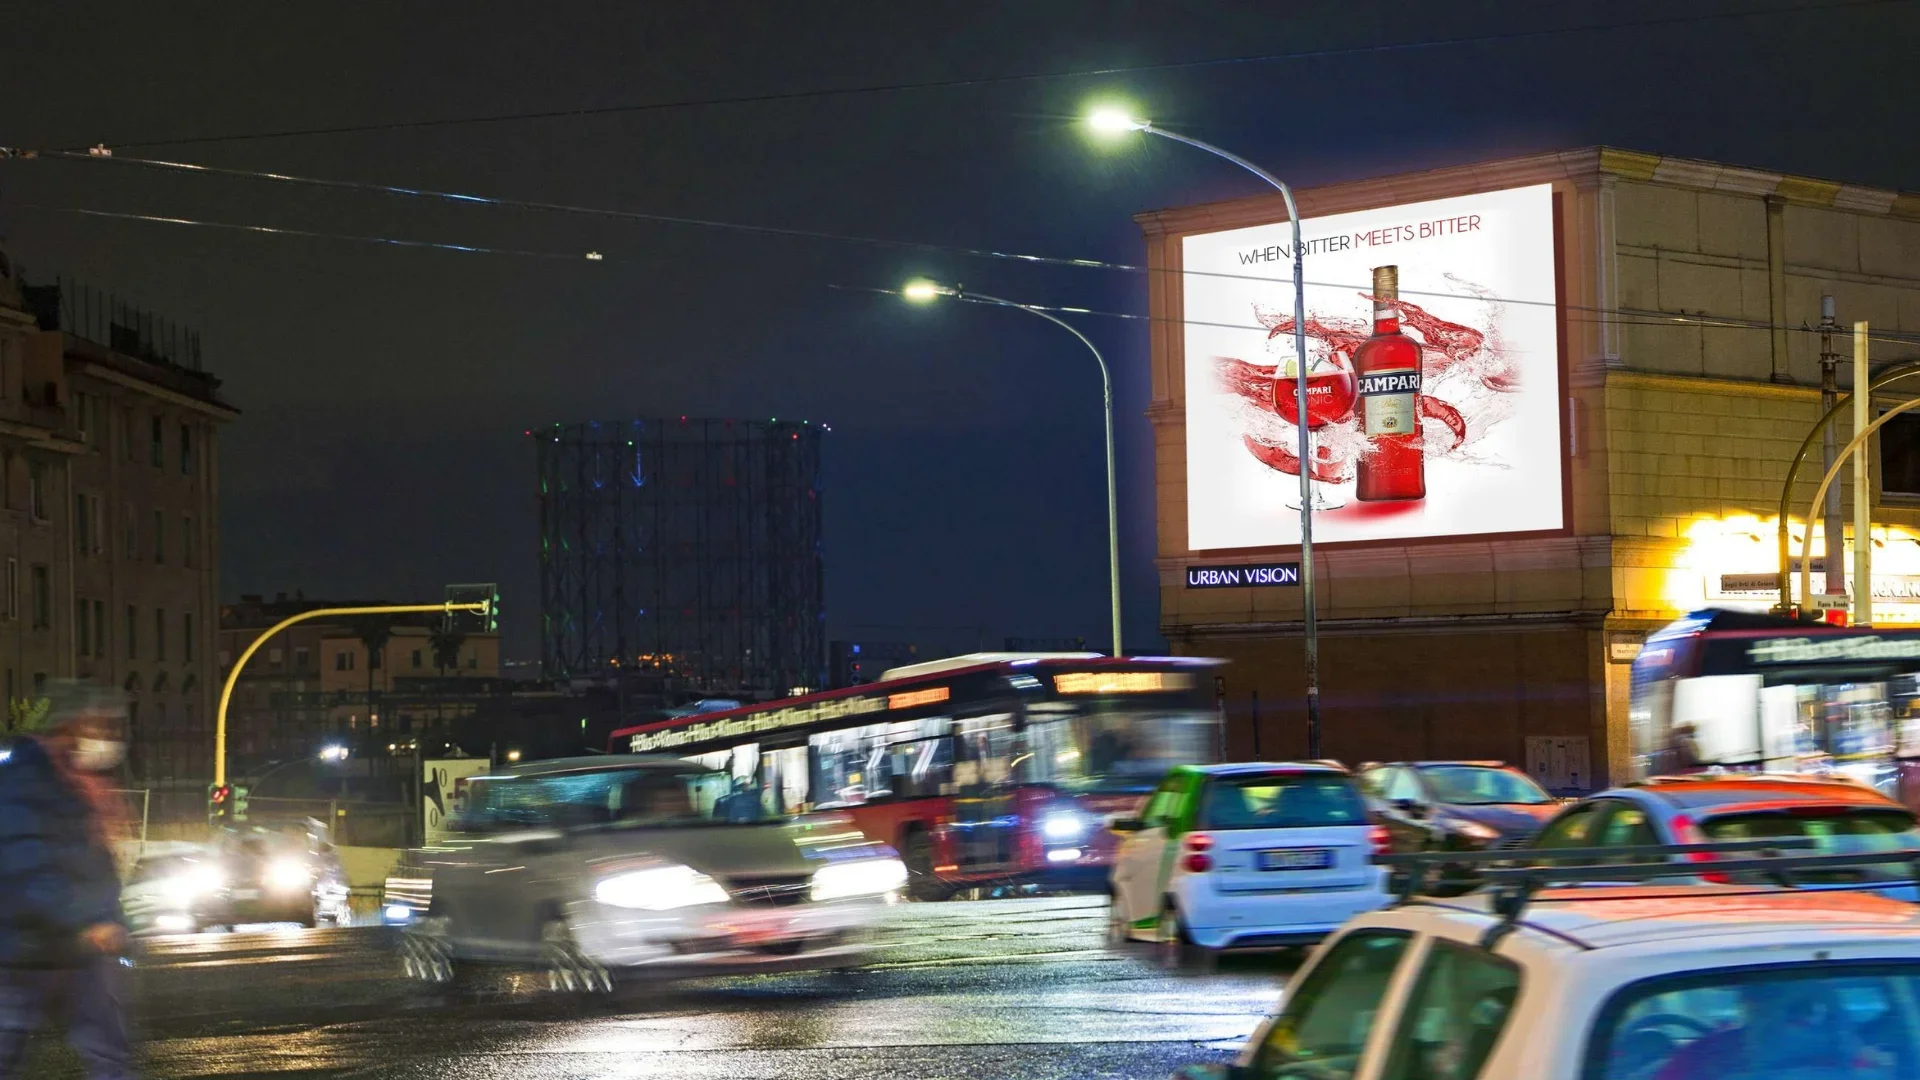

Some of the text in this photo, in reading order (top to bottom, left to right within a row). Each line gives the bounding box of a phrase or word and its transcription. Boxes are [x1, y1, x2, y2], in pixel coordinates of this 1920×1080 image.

[1238, 243, 1291, 265] WHEN
[1355, 225, 1415, 249] MEETS
[1419, 214, 1481, 239] BITTER
[1292, 385, 1333, 397] CMPARI
[1357, 374, 1420, 394] CAMPARI
[1189, 567, 1298, 585] URBAN VISION
